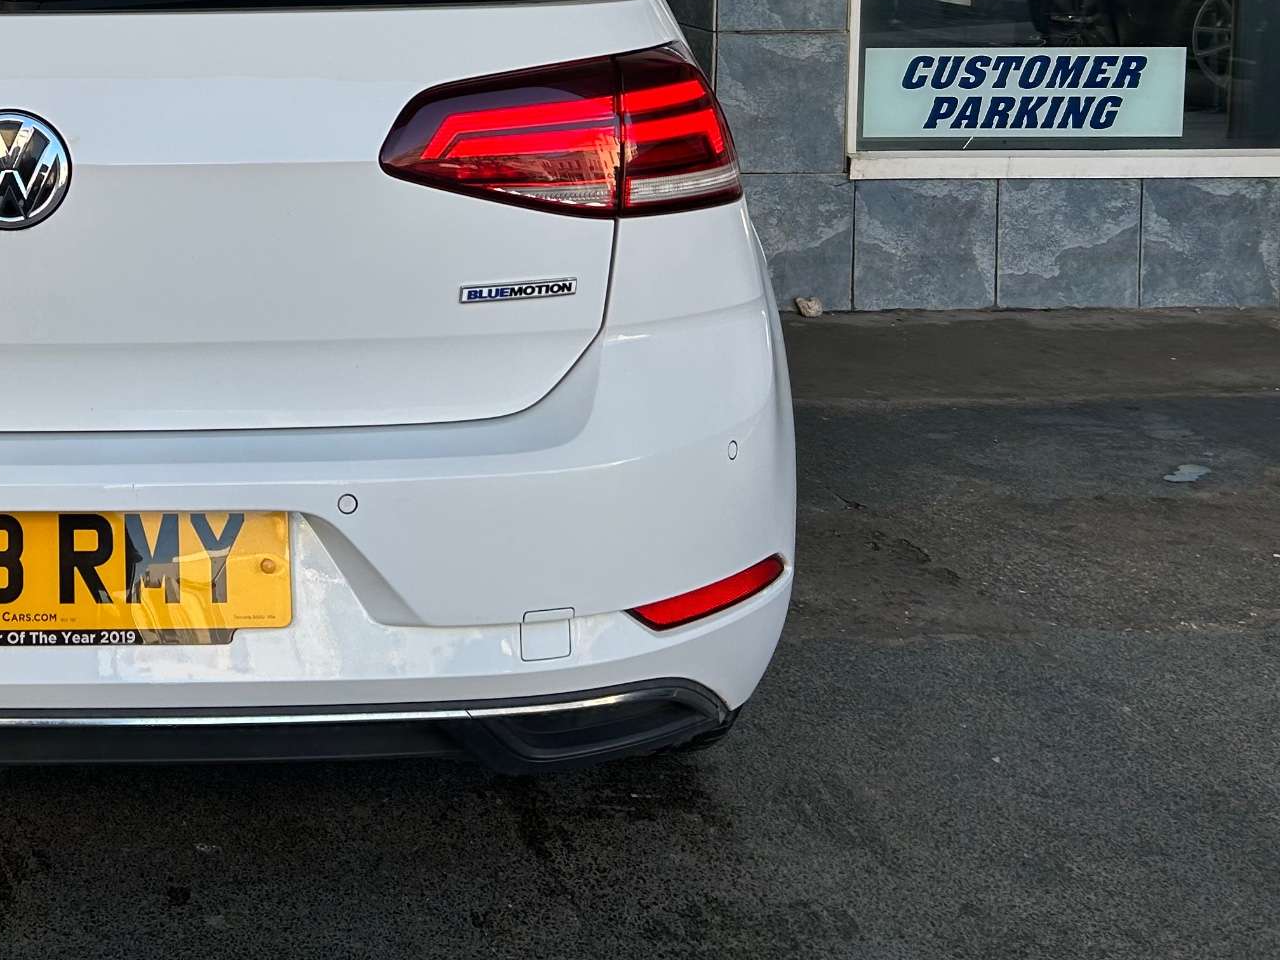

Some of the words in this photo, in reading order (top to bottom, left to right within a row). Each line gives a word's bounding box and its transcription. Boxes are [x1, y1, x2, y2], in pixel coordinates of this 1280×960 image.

[901, 55, 1148, 90] CUSTOMER
[922, 95, 1124, 130] PARKING
[466, 282, 573, 301] BLUEMOTION
[58, 513, 246, 605] RMY
[7, 632, 25, 645] Of
[29, 632, 57, 644] The
[61, 632, 96, 644] Year
[100, 631, 136, 644] 2019
